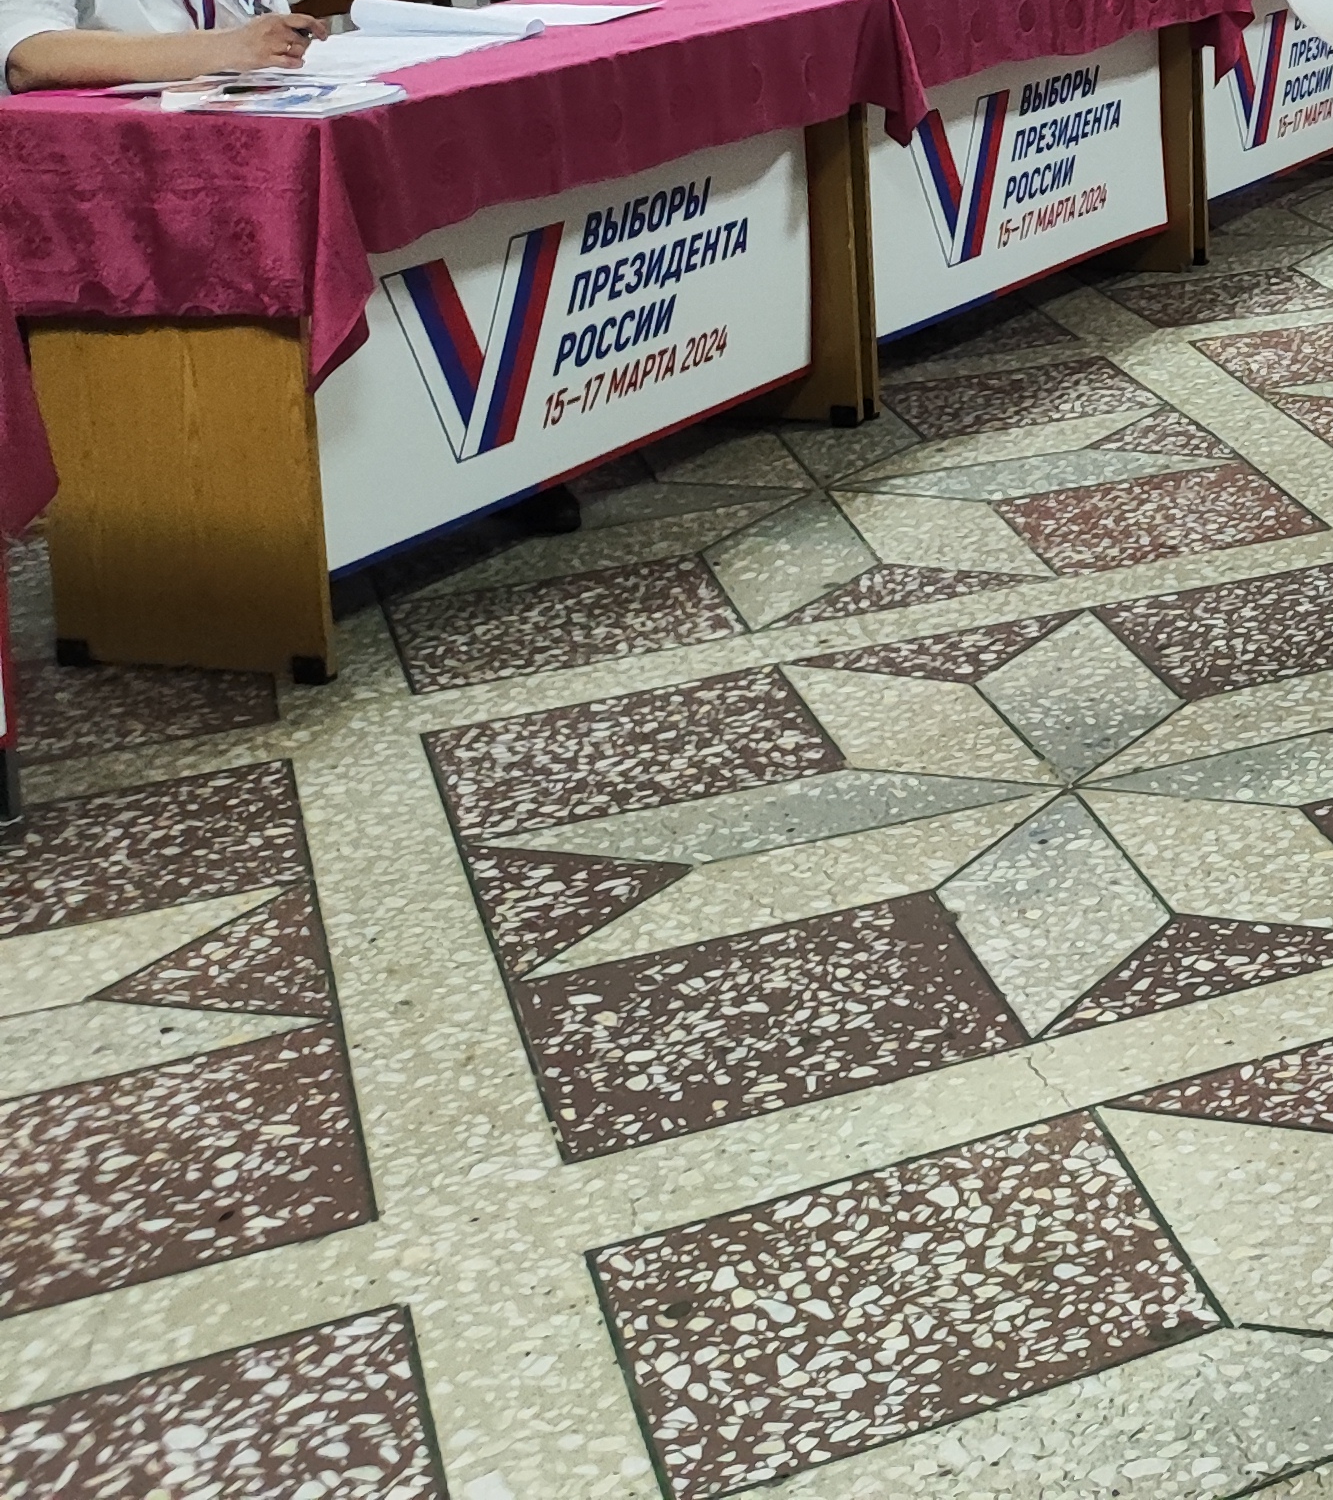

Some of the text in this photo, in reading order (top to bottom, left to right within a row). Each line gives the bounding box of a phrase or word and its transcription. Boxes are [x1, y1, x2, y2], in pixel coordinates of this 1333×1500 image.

[1019, 64, 1100, 116] ВЫБОРЫ
[1282, 64, 1333, 107] РОССИИ
[1302, 97, 1333, 130] МАРТА
[1010, 99, 1121, 163] ПРЕЗИДЕНТА
[1003, 155, 1076, 209] РОССИИ
[1034, 194, 1076, 235] МАРТА
[1077, 182, 1108, 218] 2024
[580, 176, 712, 255] ВЫБОРЫ
[567, 217, 749, 316] ПРЕЗИДЕНТА
[552, 293, 677, 377] РОССИИ
[606, 344, 677, 405] МАРТА
[679, 324, 728, 374] 2024
